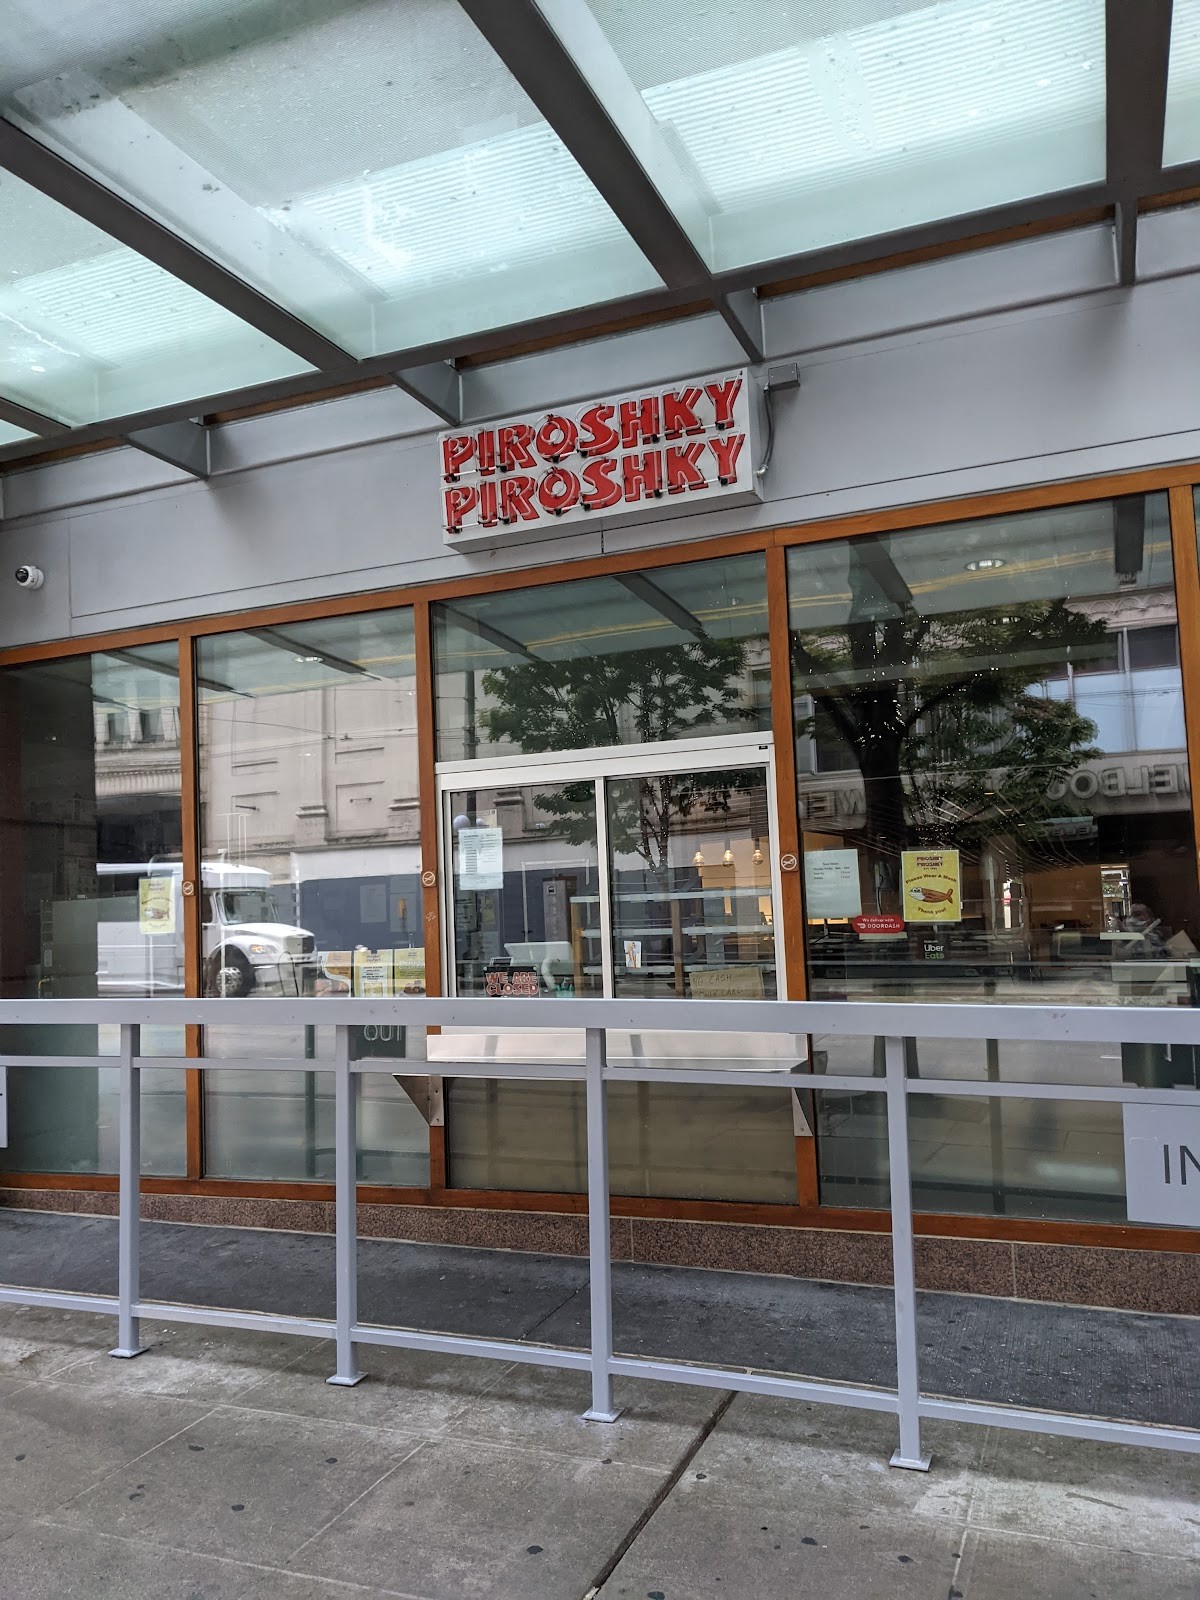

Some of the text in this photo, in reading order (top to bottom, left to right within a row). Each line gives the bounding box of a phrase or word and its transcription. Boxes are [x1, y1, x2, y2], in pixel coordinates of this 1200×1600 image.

[441, 377, 743, 483] PIROSHKY
[442, 432, 746, 534] PIROSHKY
[905, 876, 923, 884] Please
[943, 874, 957, 883] Mask
[917, 906, 934, 914] Thank
[923, 944, 944, 952] Uber
[925, 952, 945, 960] Eats
[485, 972, 538, 984] WE ARE
[709, 974, 732, 985] CASH
[486, 983, 539, 995] CLOSED
